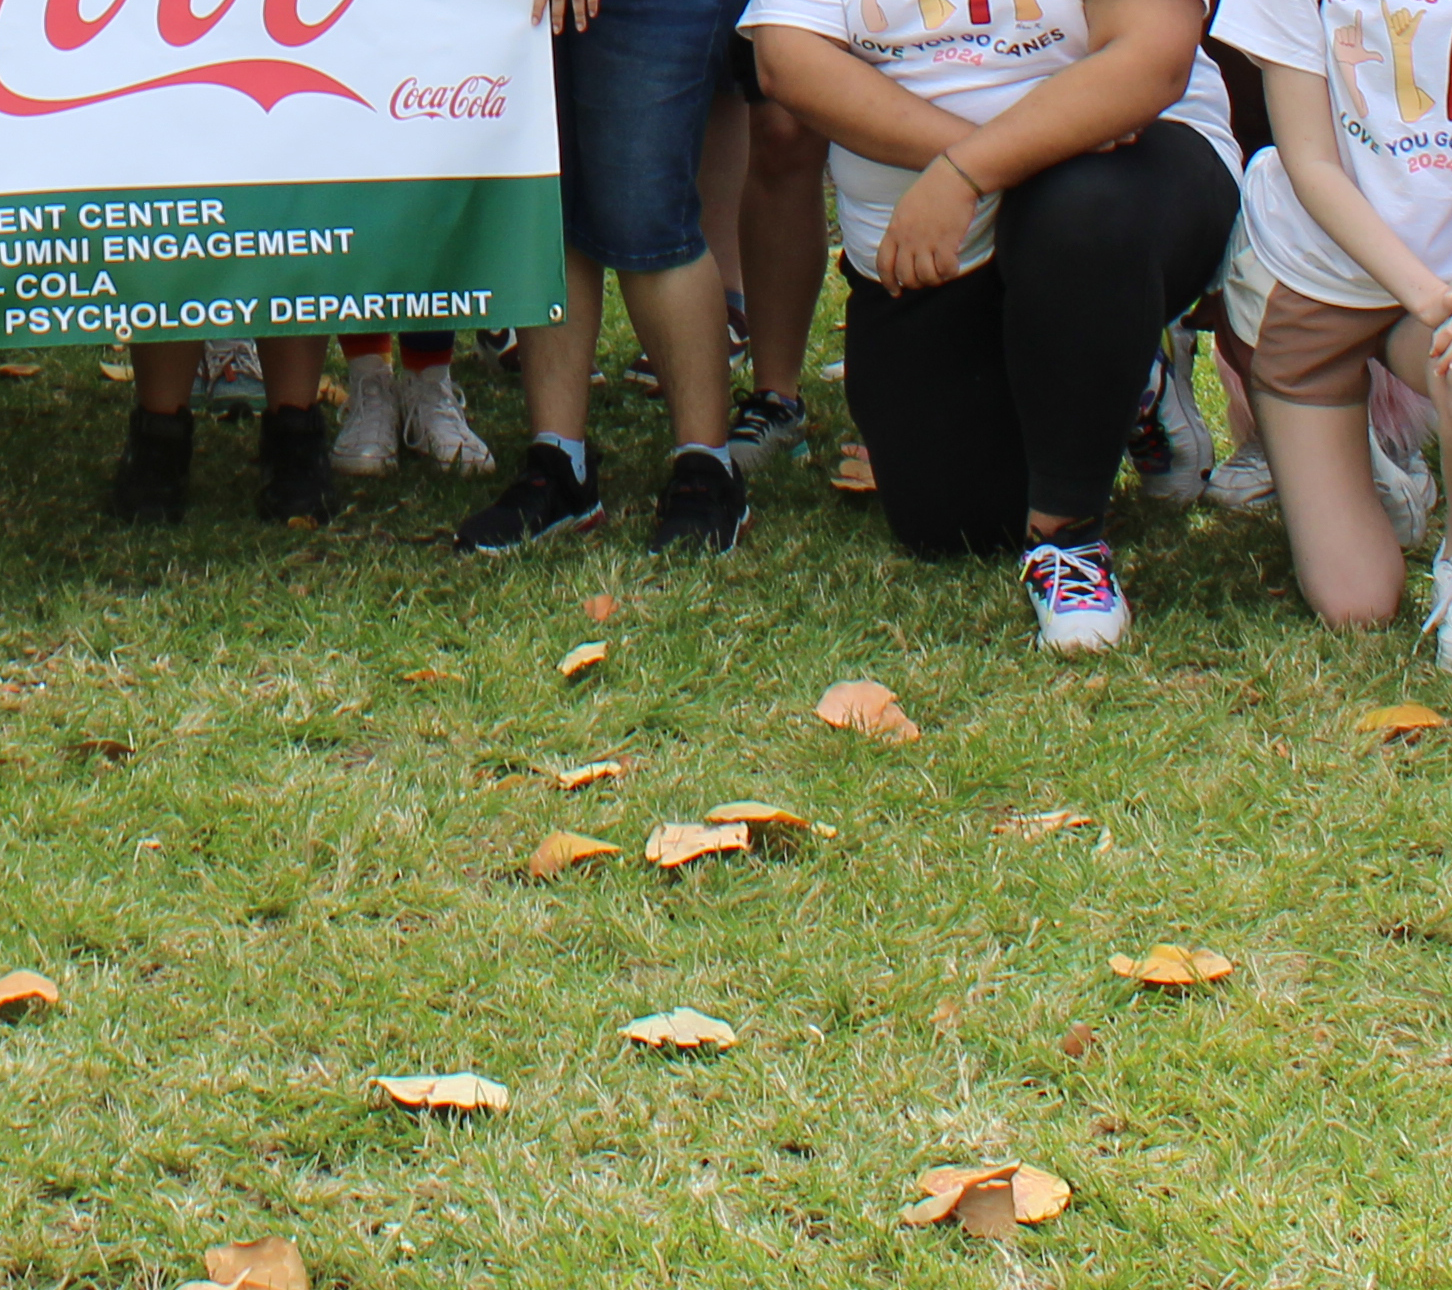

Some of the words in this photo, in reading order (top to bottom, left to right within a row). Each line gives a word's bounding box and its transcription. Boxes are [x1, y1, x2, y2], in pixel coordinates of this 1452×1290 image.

[852, 32, 904, 59] LOVE
[993, 28, 1066, 57] CANES
[933, 48, 983, 66] 2024
[1340, 112, 1380, 155] LOVE
[1386, 131, 1430, 157] YOU
[78, 199, 224, 230] CENTER
[103, 228, 353, 263] ENGAGEMENT
[14, 270, 116, 301] COLA
[4, 297, 259, 335] PSYCHOLOGY
[270, 290, 492, 323] DEPARTMENT
